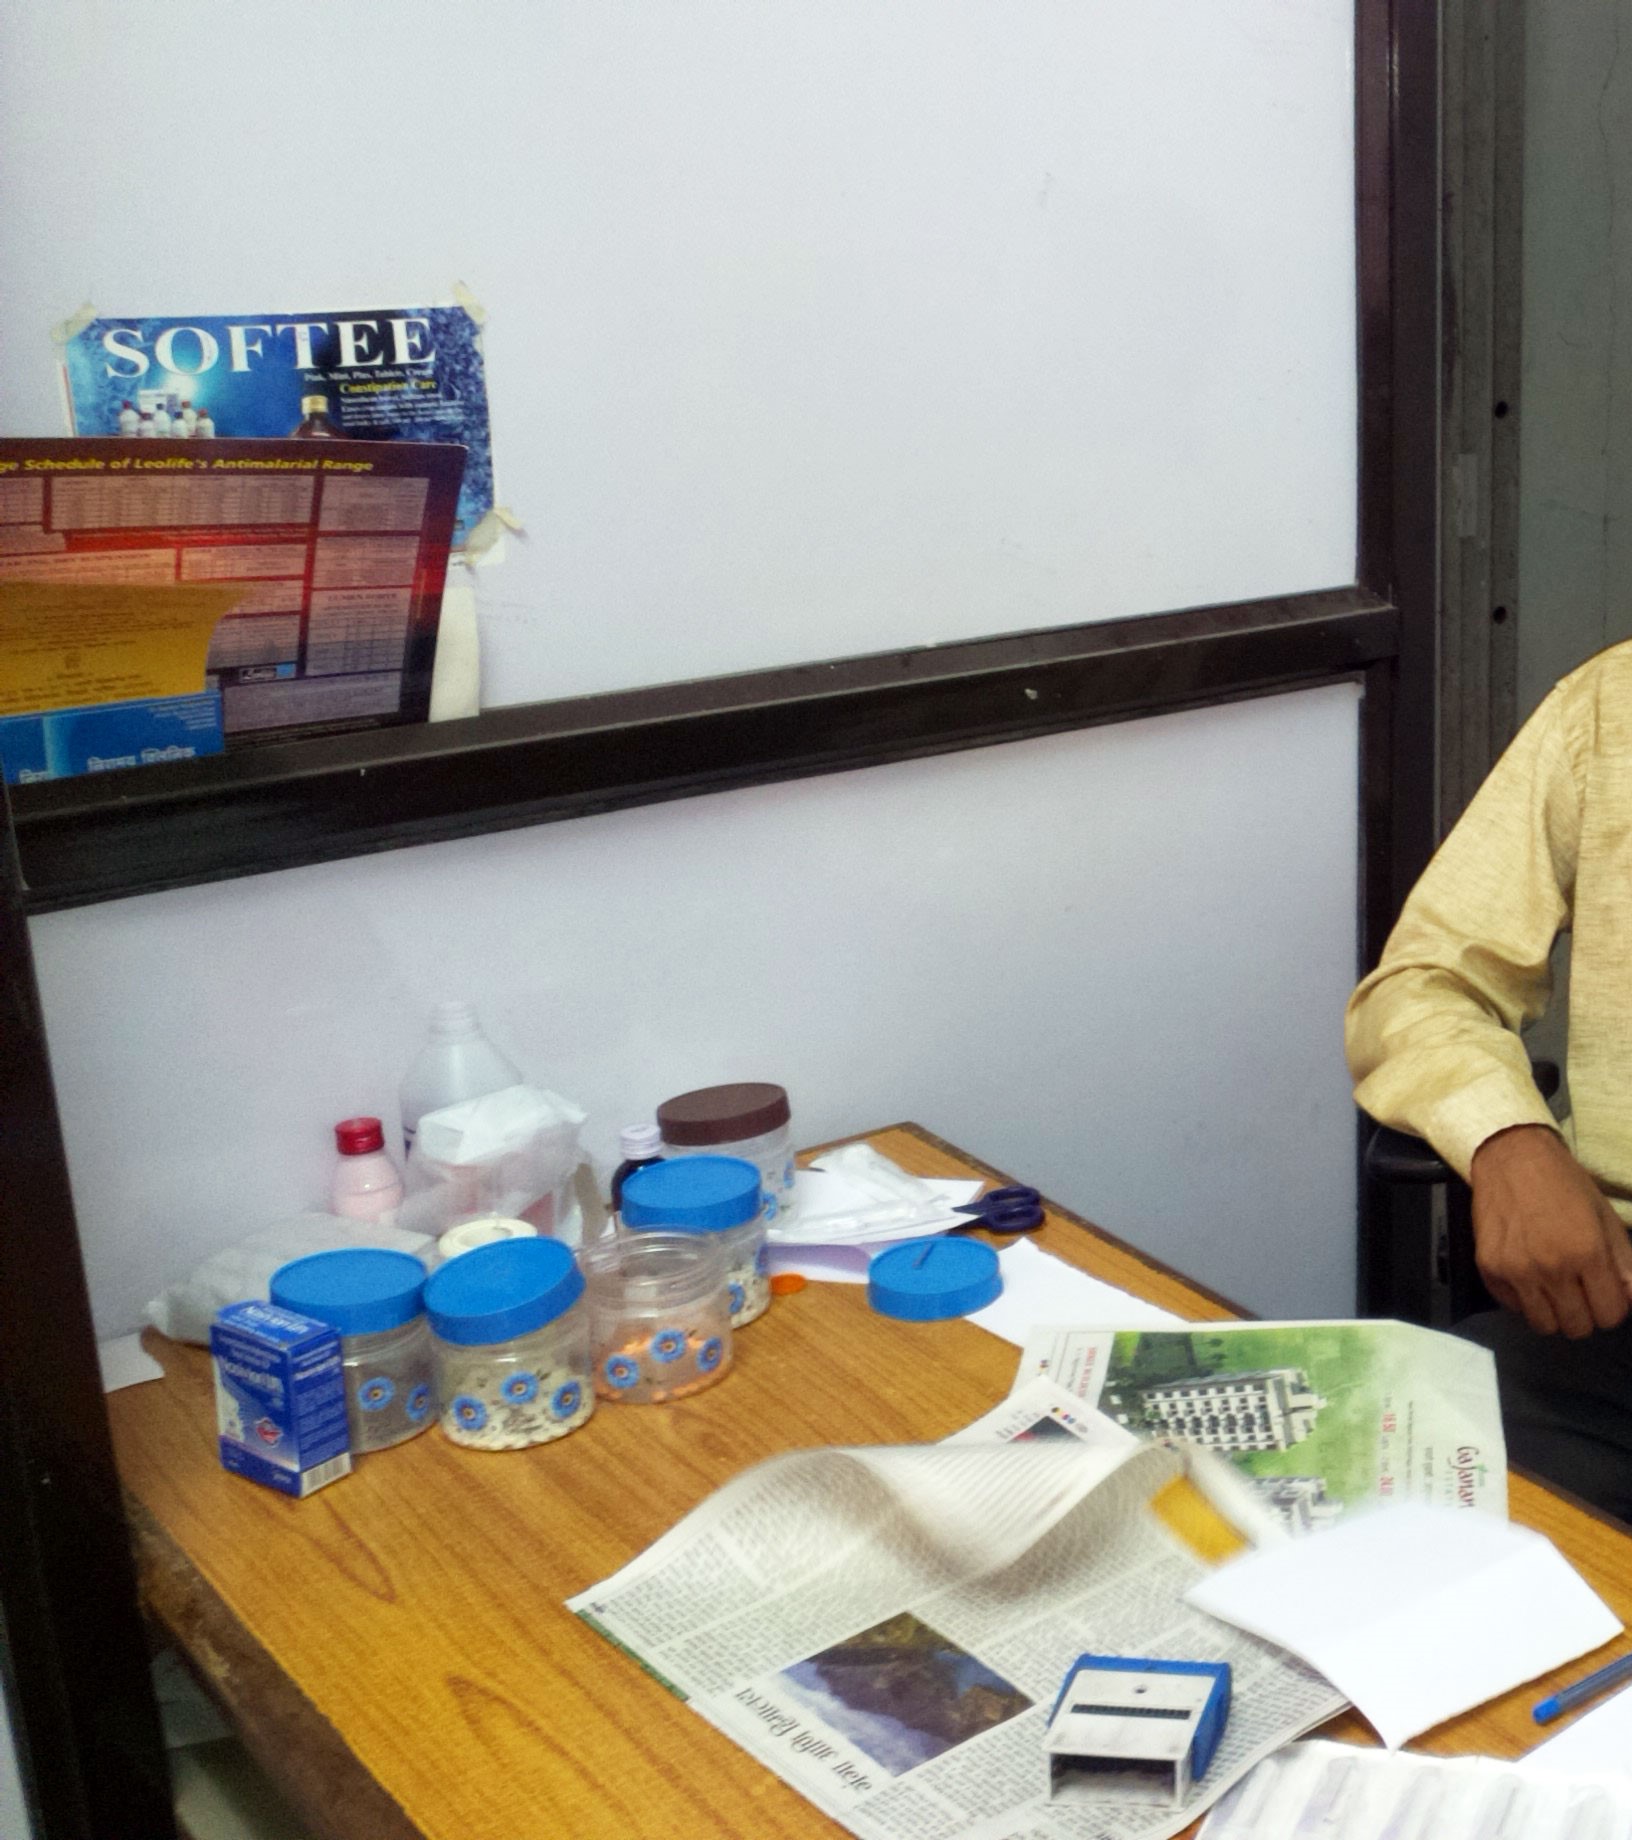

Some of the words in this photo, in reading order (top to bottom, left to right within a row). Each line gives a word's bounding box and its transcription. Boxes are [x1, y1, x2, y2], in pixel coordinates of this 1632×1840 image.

[102, 317, 436, 379] SOFTEE
[24, 458, 105, 470] Schedule
[110, 457, 132, 469] of
[213, 458, 319, 470] Antimalarial
[322, 459, 374, 473] Range
